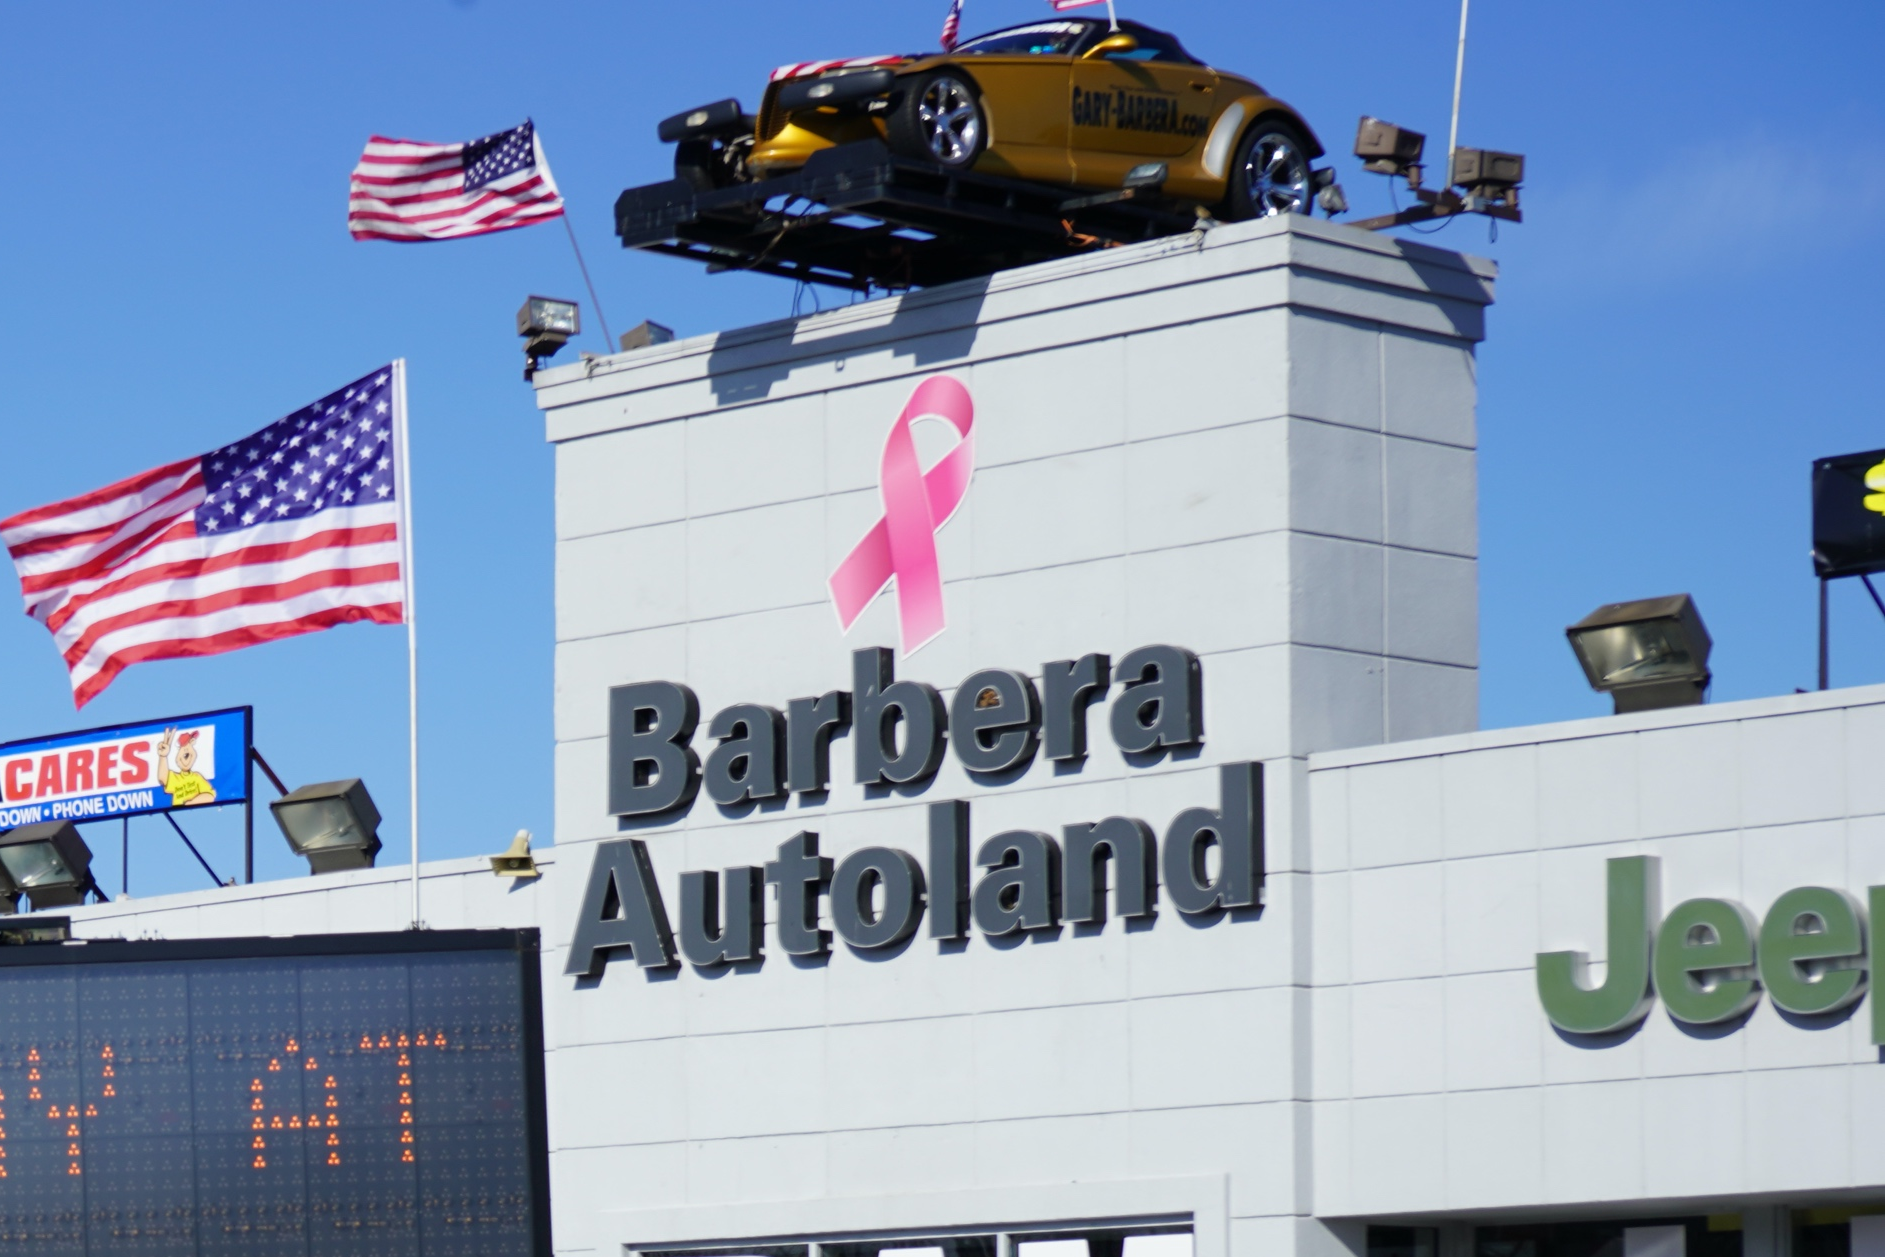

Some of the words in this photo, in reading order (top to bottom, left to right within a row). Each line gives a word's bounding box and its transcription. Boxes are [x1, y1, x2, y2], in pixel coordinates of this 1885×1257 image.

[52, 796, 105, 819] PHONE
[107, 789, 154, 812] DOWN
[607, 643, 1205, 818] Barbera
[563, 760, 1266, 977] Autoland
[1534, 854, 1885, 1047] Jee
[248, 1032, 447, 1170] AT
